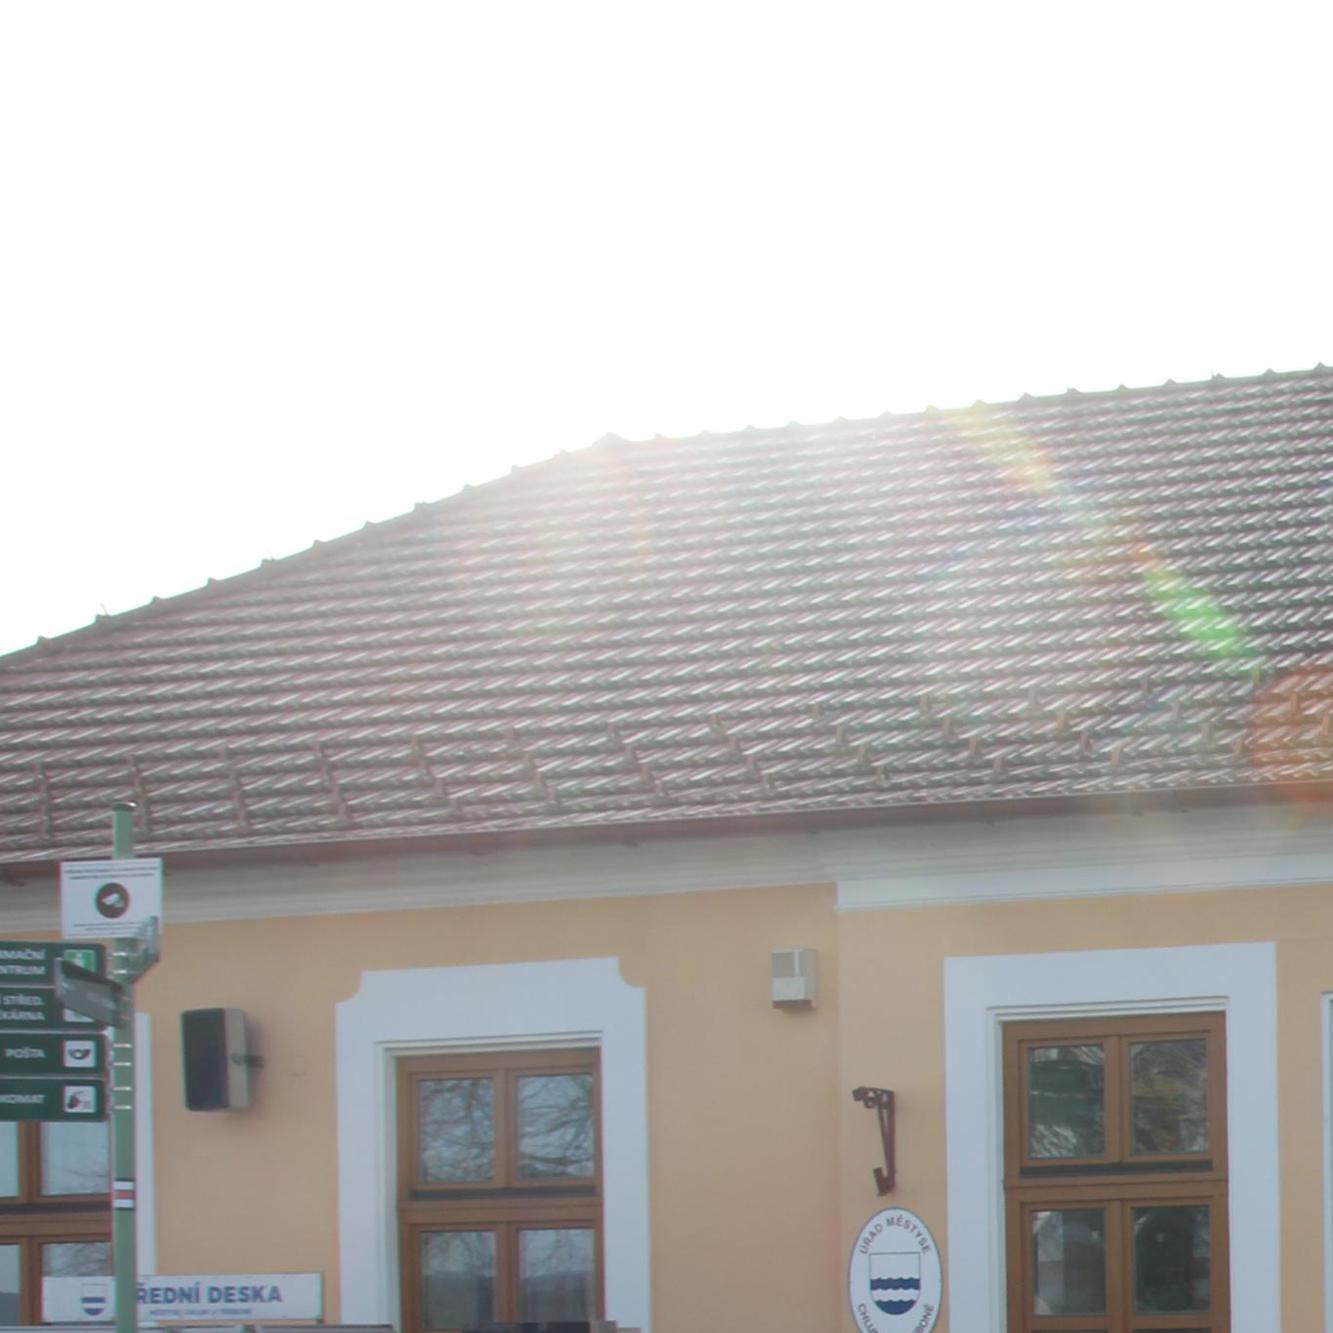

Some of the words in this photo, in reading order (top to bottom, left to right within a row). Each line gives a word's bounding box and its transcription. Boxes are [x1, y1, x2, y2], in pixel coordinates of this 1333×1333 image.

[5, 1046, 46, 1059] POŠTA
[136, 1281, 201, 1304] ŘEDNÍ
[207, 1285, 284, 1304] DESKA
